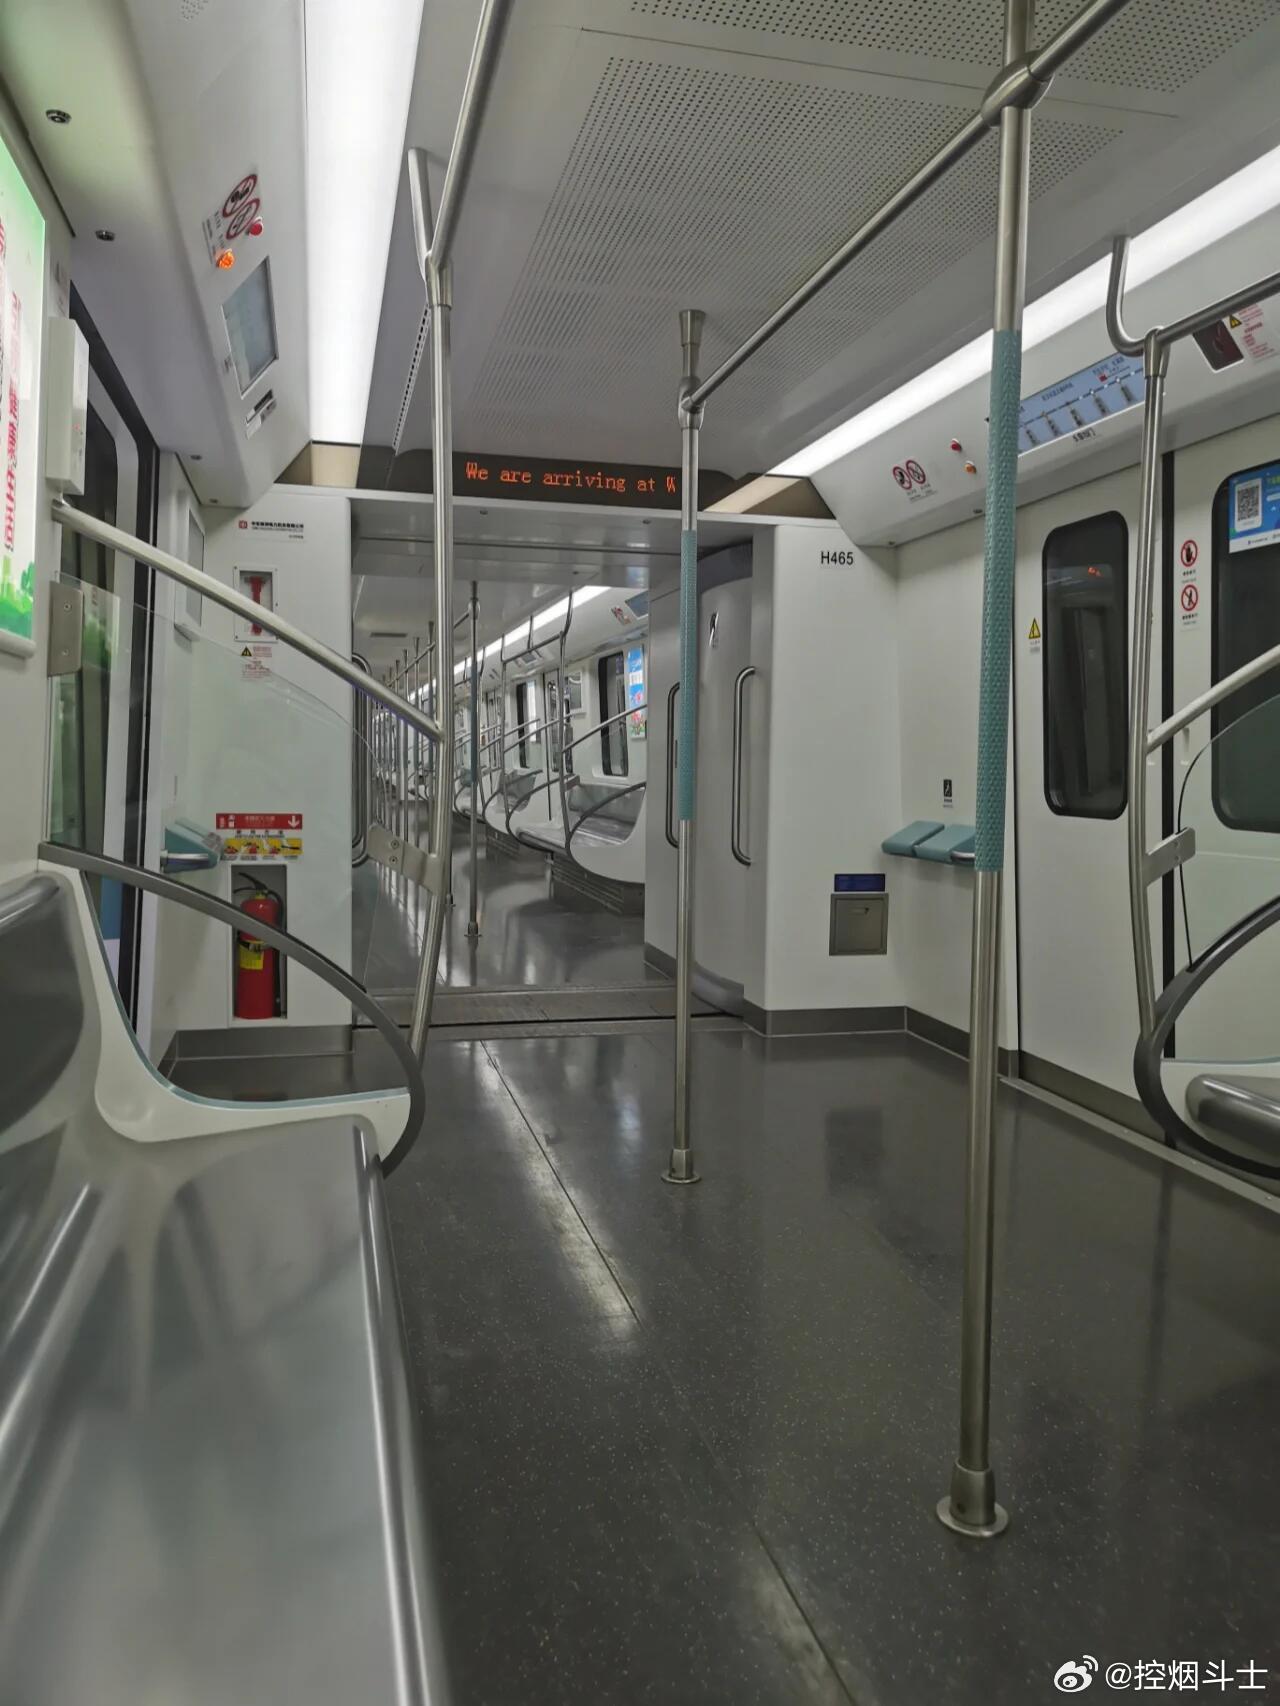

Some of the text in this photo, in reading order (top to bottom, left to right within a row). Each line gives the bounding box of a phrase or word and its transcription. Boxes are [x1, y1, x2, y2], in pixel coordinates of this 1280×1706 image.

[465, 462, 489, 481] We
[500, 469, 532, 484] are
[543, 470, 626, 493] arriving
[637, 474, 656, 492] at
[820, 551, 854, 566] H465
